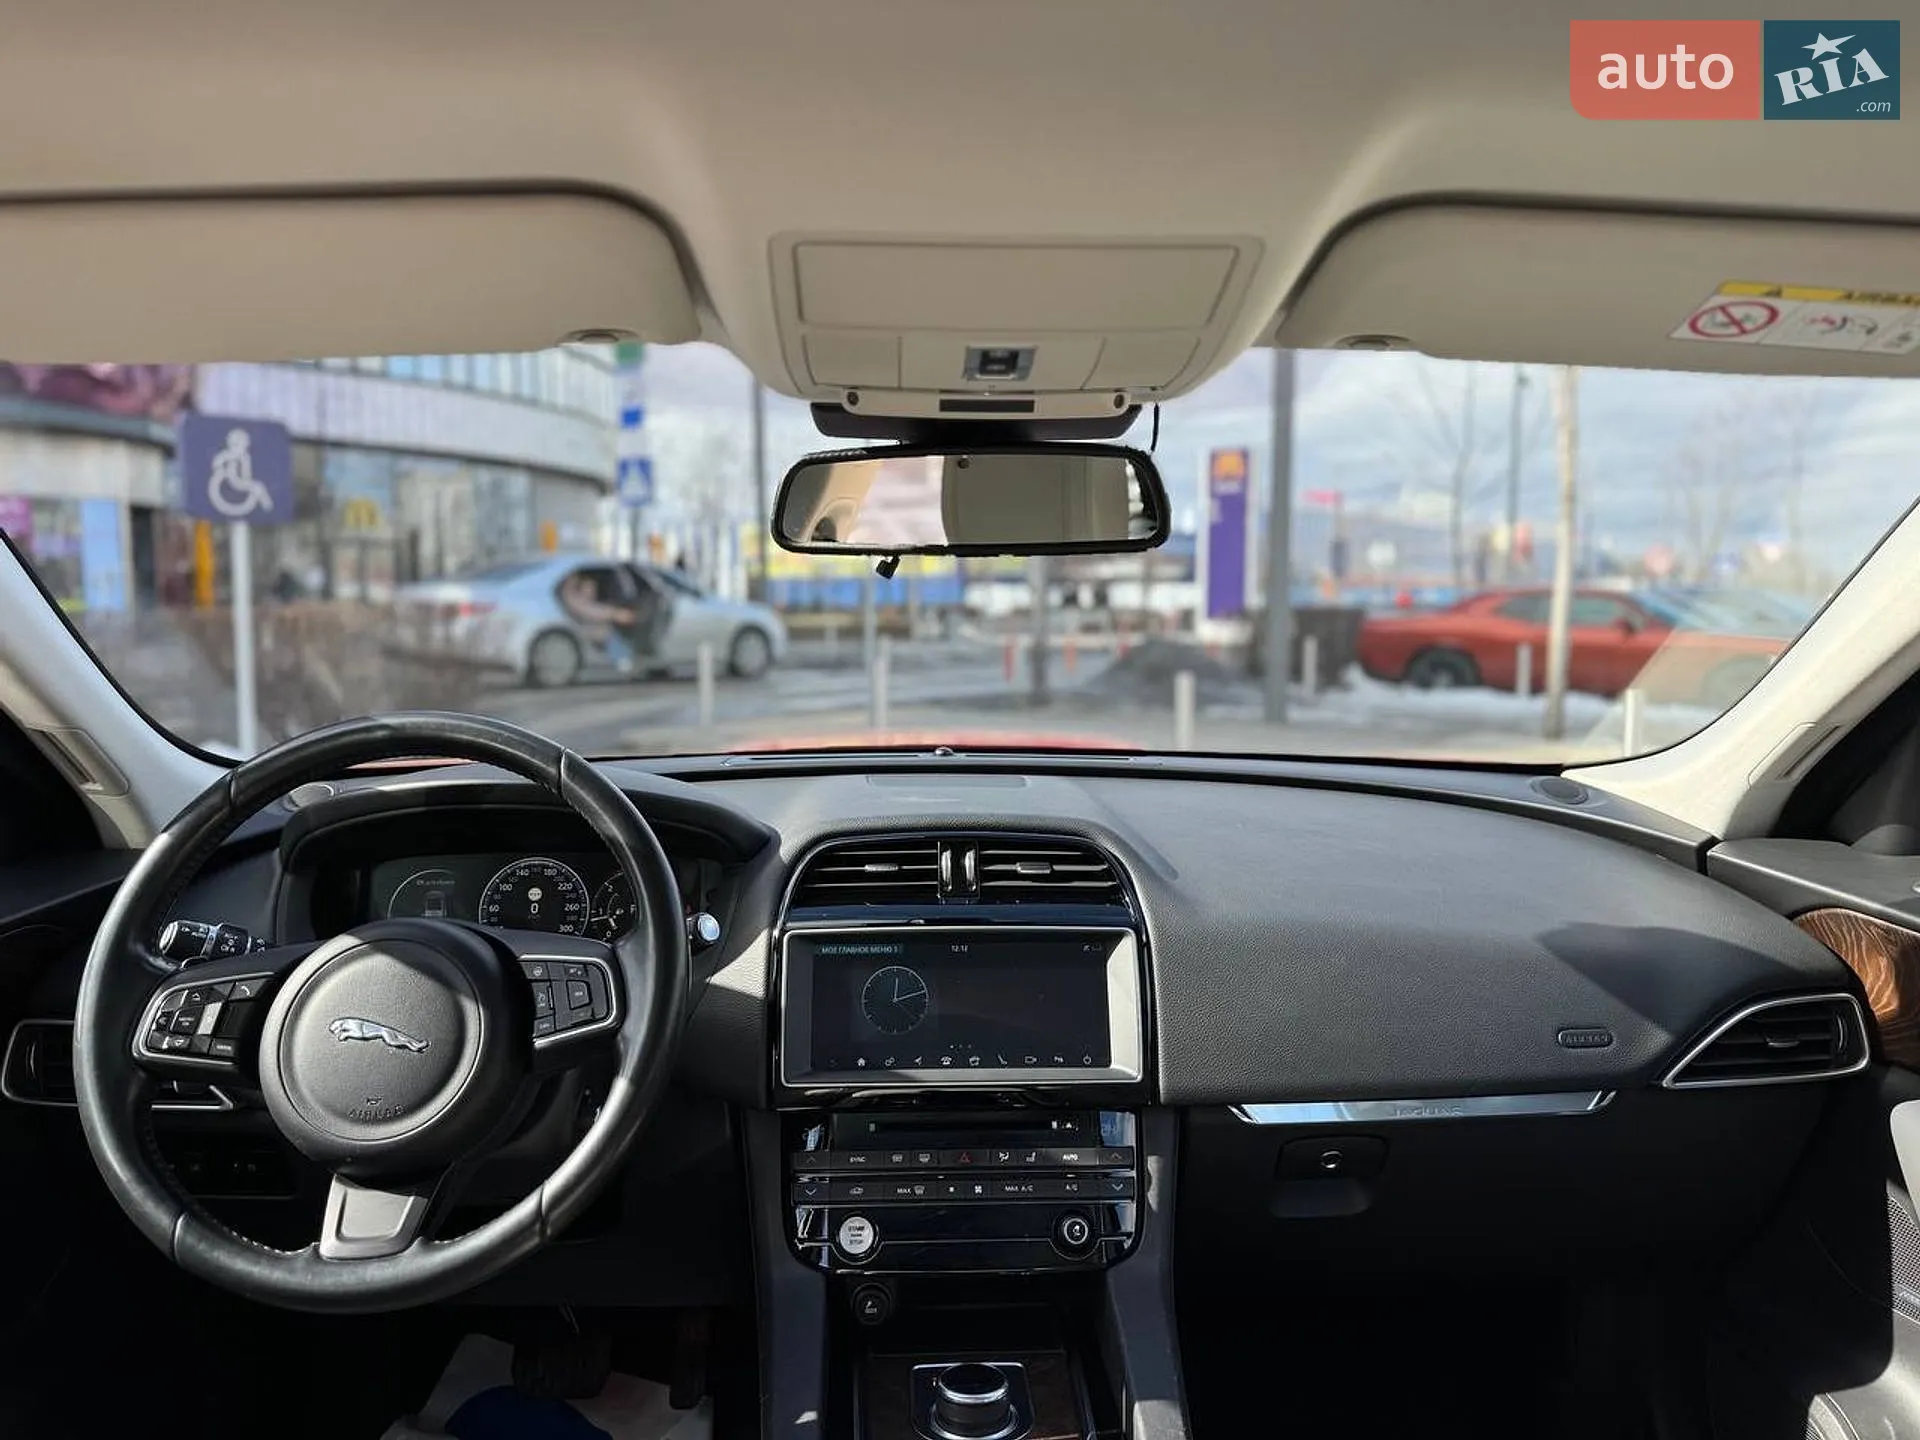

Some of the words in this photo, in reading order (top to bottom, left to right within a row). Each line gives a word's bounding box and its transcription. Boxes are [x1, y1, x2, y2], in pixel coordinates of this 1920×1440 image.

[499, 883, 513, 891] 100
[558, 882, 573, 890] 220
[488, 904, 500, 912] 60
[530, 902, 539, 914] 0
[563, 903, 580, 911] 260
[559, 924, 574, 933] 300
[1062, 1153, 1078, 1161] AUTO
